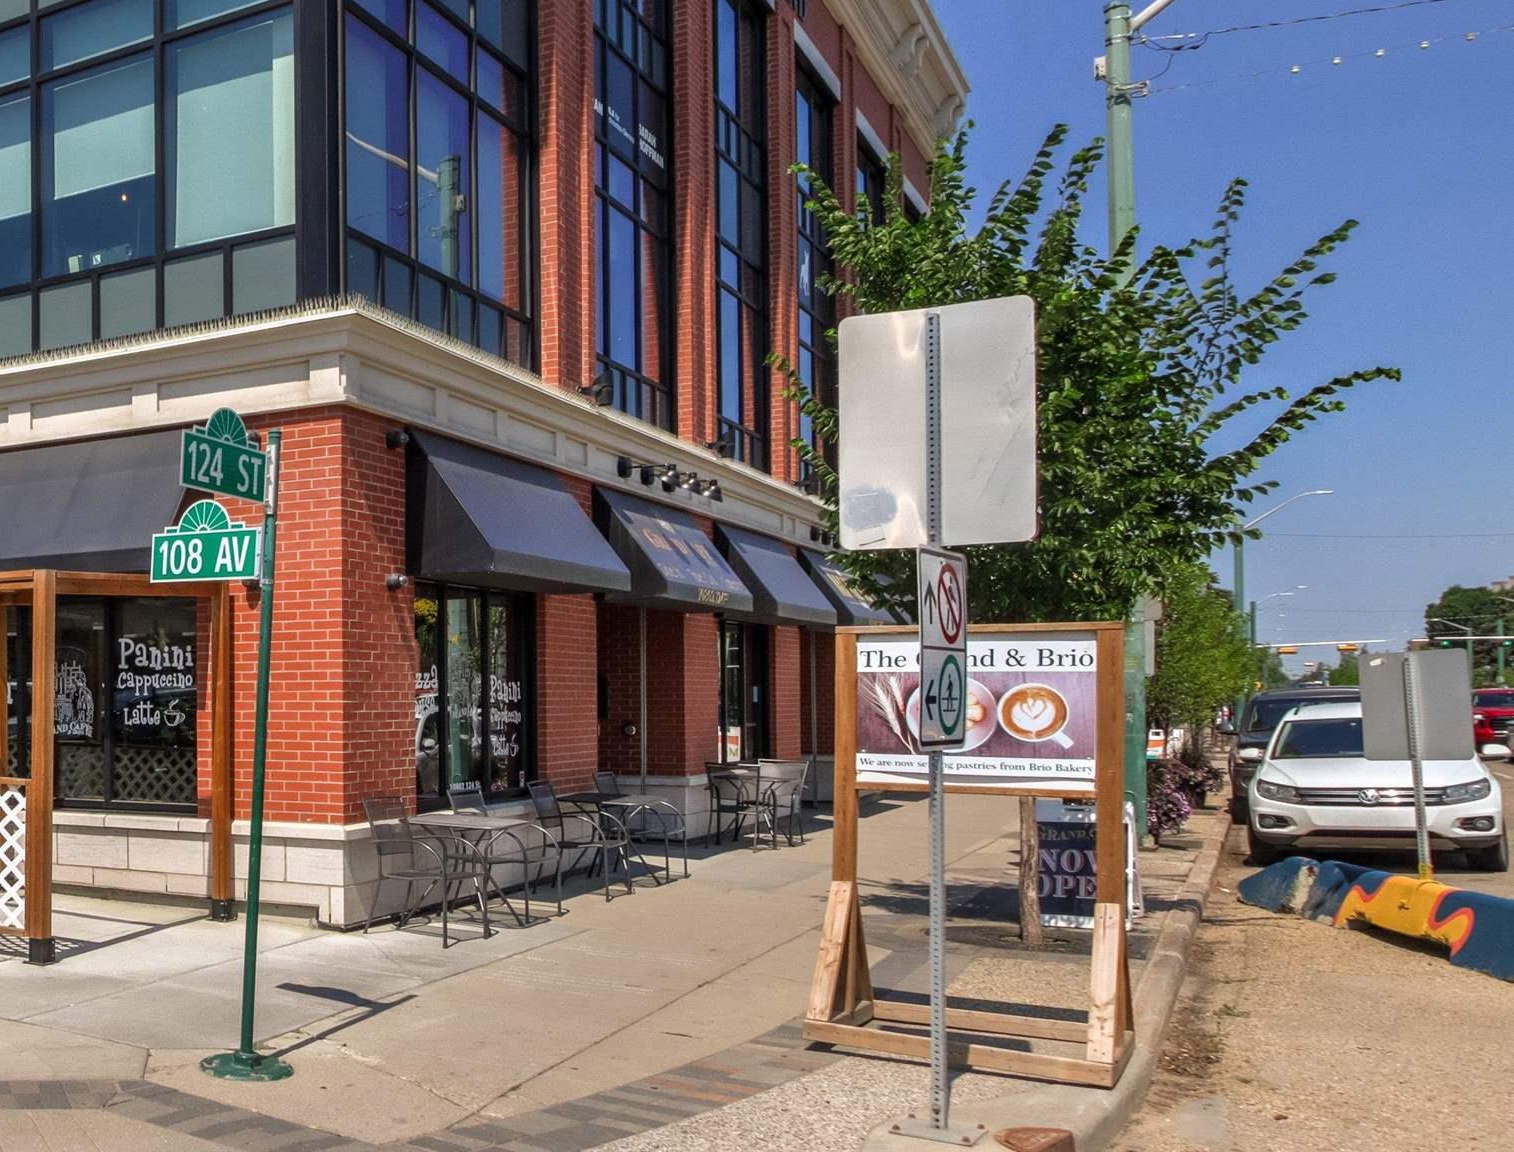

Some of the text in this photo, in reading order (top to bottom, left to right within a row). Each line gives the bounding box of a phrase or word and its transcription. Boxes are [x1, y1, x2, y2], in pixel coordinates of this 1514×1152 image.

[188, 440, 263, 495] 124 ST
[159, 535, 250, 576] 108 AV
[118, 638, 194, 671] Panini
[860, 649, 907, 669] The
[1005, 648, 1027, 667] &
[415, 664, 439, 689] zza
[490, 675, 522, 703] Panini
[123, 701, 161, 726] Latte
[859, 757, 875, 767] We
[877, 759, 893, 767] are
[916, 759, 954, 771] seng
[955, 761, 997, 772] pastries
[999, 761, 1026, 771] from
[1029, 763, 1052, 772] Brio
[1055, 764, 1093, 775] Bakery
[1038, 874, 1097, 899] OPE
